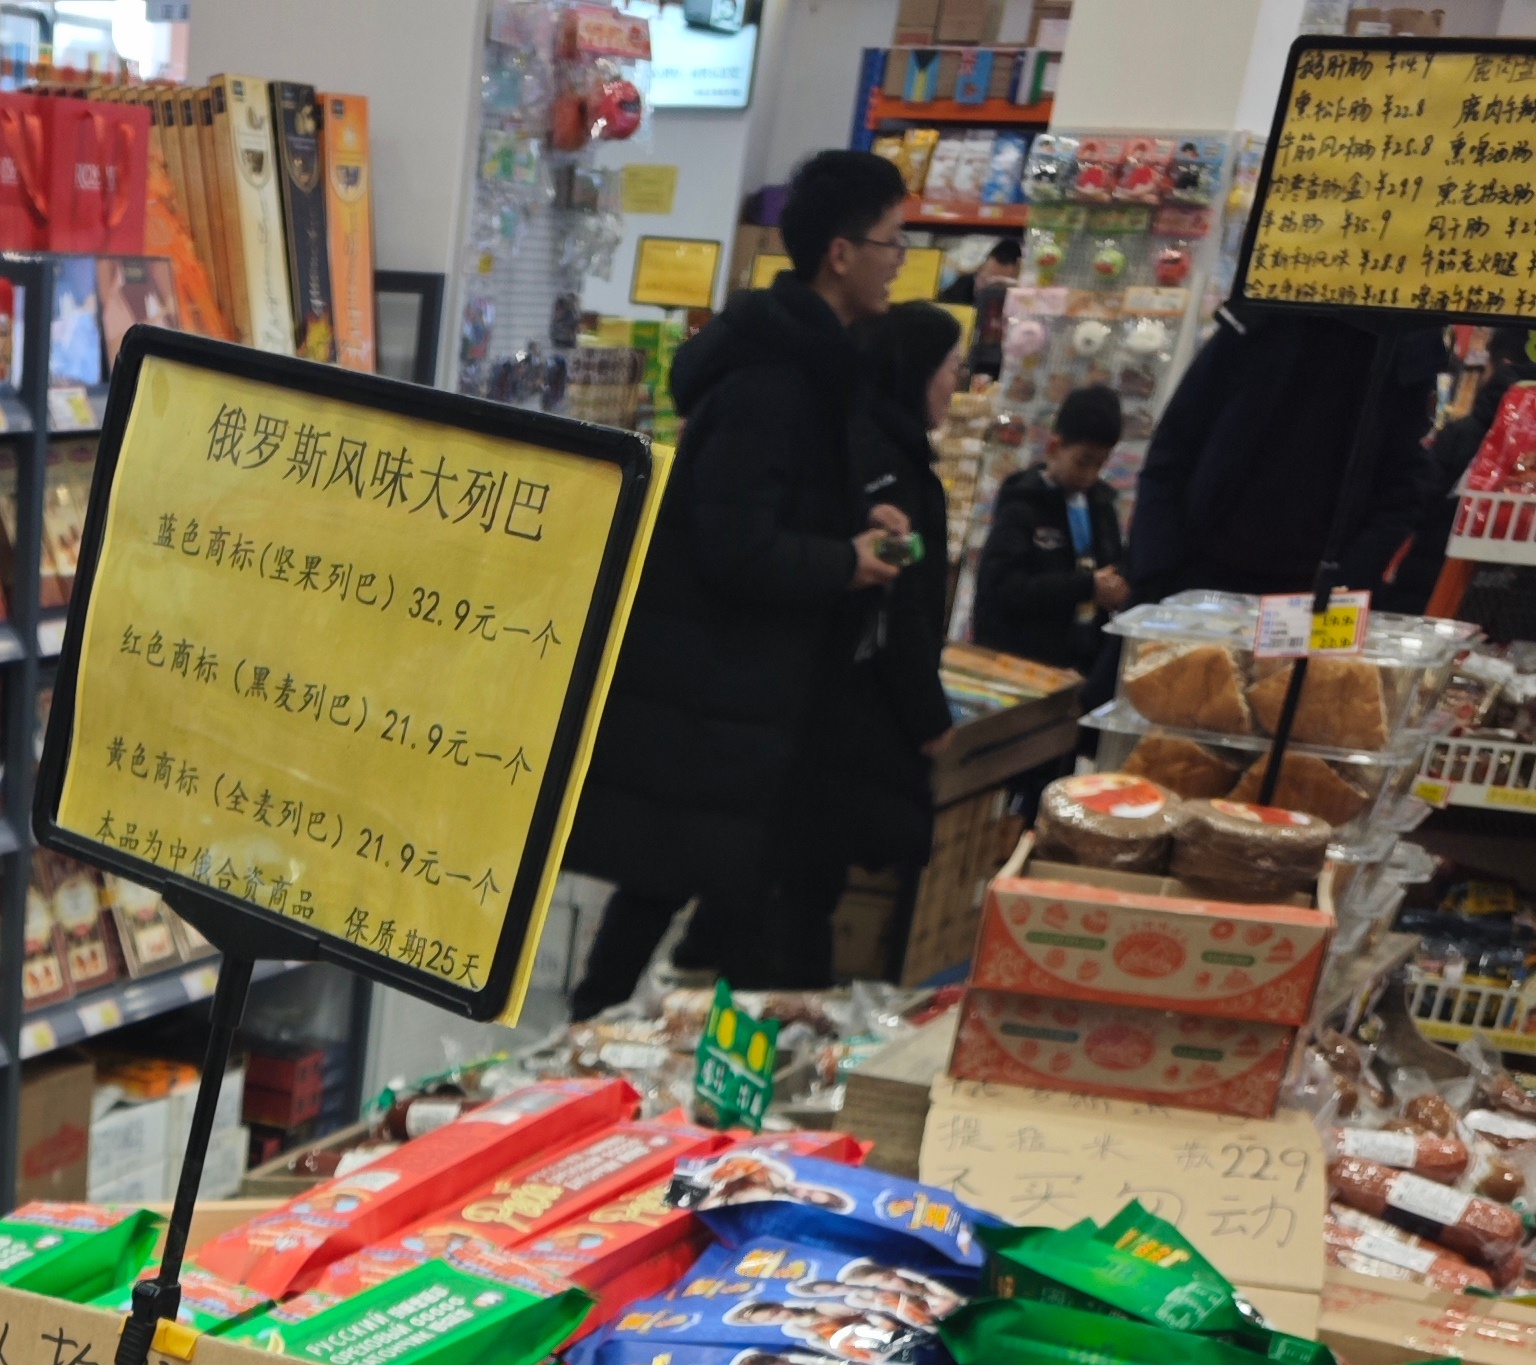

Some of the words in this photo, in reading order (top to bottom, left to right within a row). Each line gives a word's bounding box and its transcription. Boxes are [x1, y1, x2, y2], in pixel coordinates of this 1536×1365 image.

[206, 402, 550, 542] 俄罗斯风味大列巴
[94, 808, 314, 920] 本品为中俄合资商品
[343, 906, 480, 990] 保质期25天
